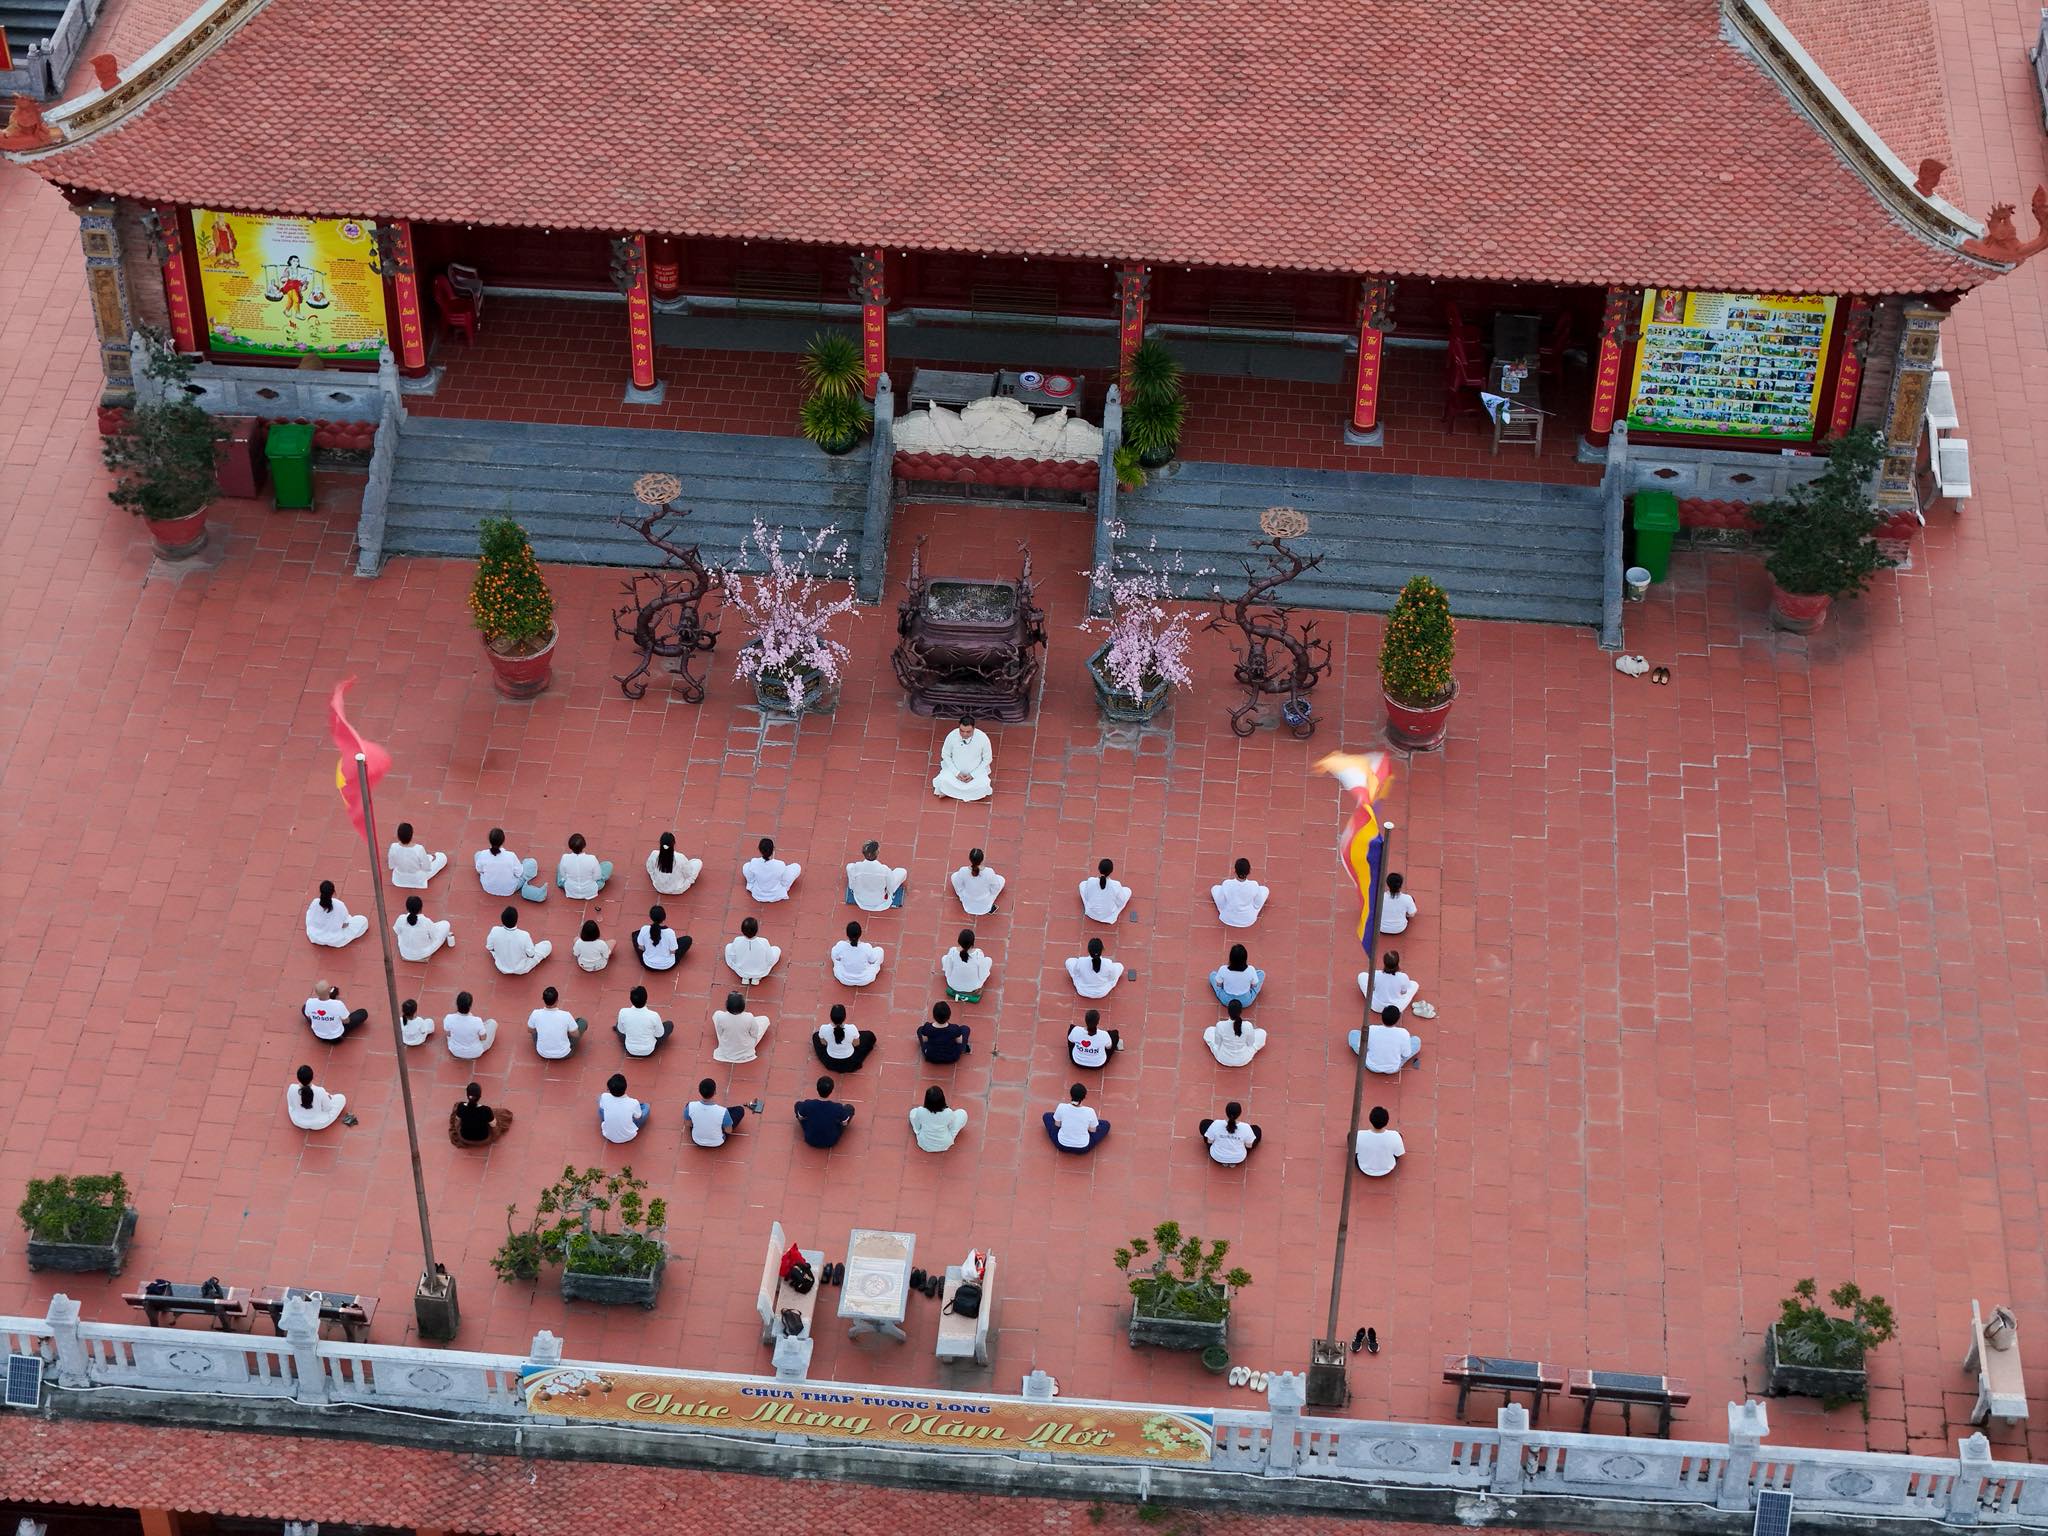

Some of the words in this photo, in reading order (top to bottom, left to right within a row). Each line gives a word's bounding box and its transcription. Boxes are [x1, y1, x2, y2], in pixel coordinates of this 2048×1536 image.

[626, 1392, 732, 1419] Chúc
[740, 1402, 876, 1435] Mừng
[887, 1413, 1011, 1440] Năm
[1015, 1422, 1115, 1446] Mới
[936, 1402, 991, 1414] LONG
